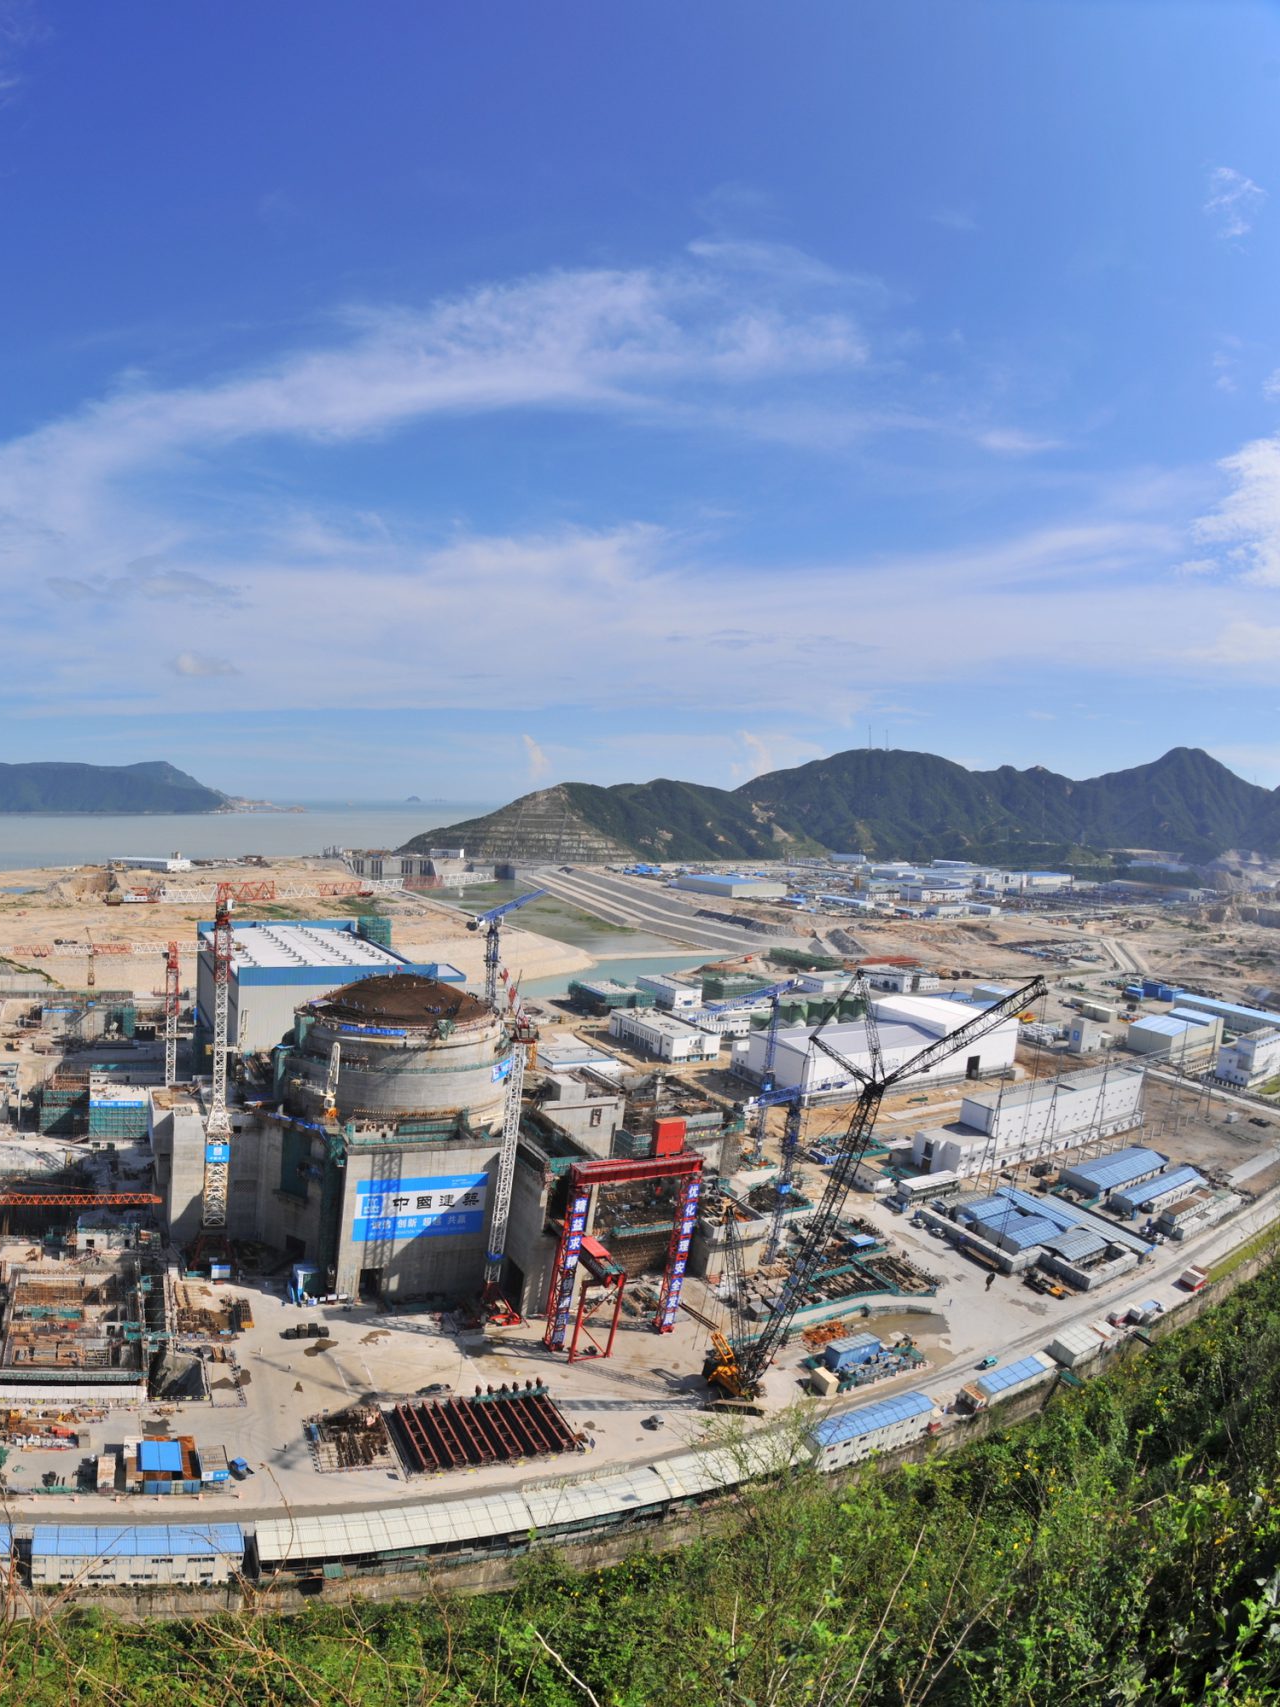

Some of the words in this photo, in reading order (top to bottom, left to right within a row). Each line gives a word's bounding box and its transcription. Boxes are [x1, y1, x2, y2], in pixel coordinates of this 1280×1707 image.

[397, 1217, 417, 1228] 创新
[422, 1215, 442, 1226] 超越
[447, 1214, 467, 1225] 共赢
